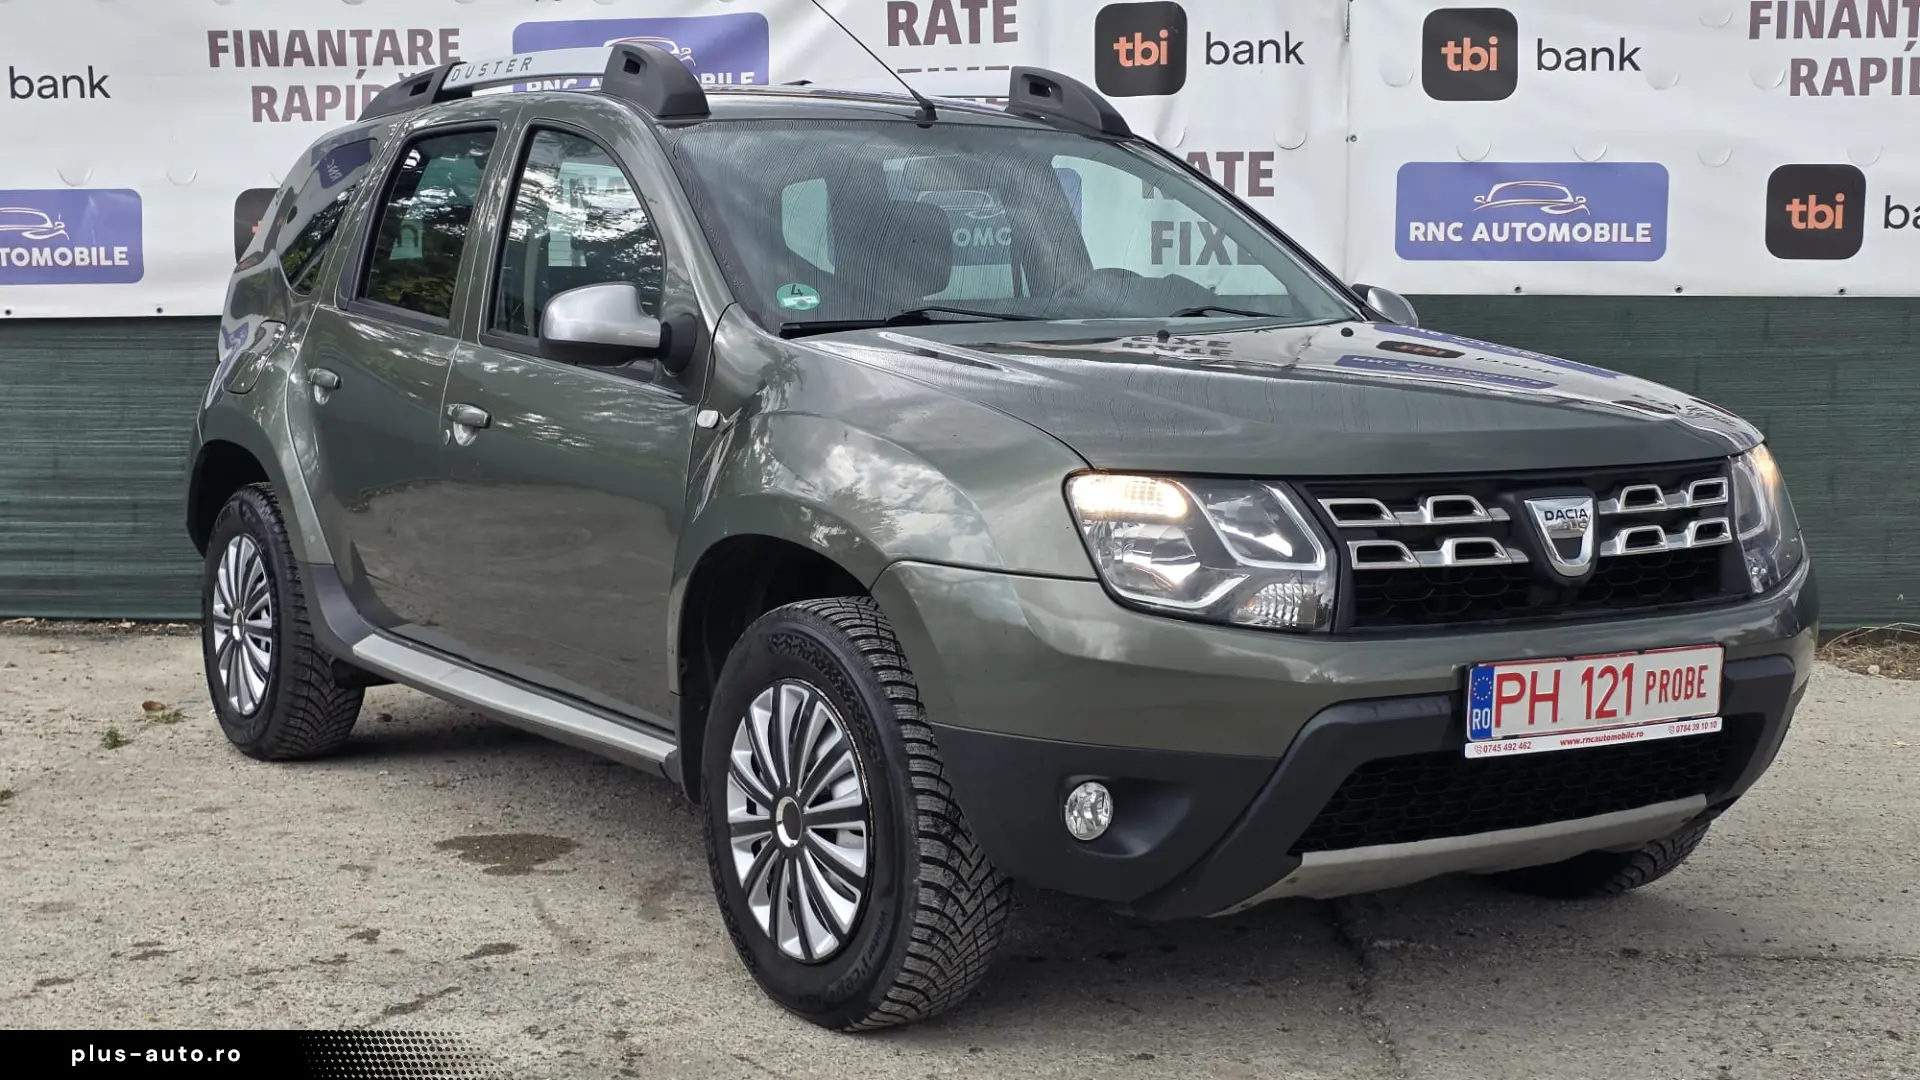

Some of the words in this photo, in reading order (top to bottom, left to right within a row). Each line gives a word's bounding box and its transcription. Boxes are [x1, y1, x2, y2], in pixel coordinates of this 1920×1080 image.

[887, 0, 1018, 46] RATE
[1113, 30, 1168, 67] tbi
[1205, 31, 1304, 65] bank
[1441, 36, 1498, 71] tbi
[1536, 38, 1641, 71] bank
[9, 66, 110, 99] bank
[451, 57, 532, 82] DUSTER
[1785, 192, 1845, 230] tbi
[1409, 222, 1463, 242] RNC
[1471, 221, 1651, 243] AUTOMOBILE
[1544, 508, 1588, 521] DACIA
[1494, 669, 1561, 728] PH
[1581, 663, 1635, 720] 121
[1645, 665, 1708, 705] PROBE
[1472, 707, 1491, 730] RO
[1504, 743, 1517, 751] 492
[1560, 731, 1644, 746] www.rncautomobile.ro
